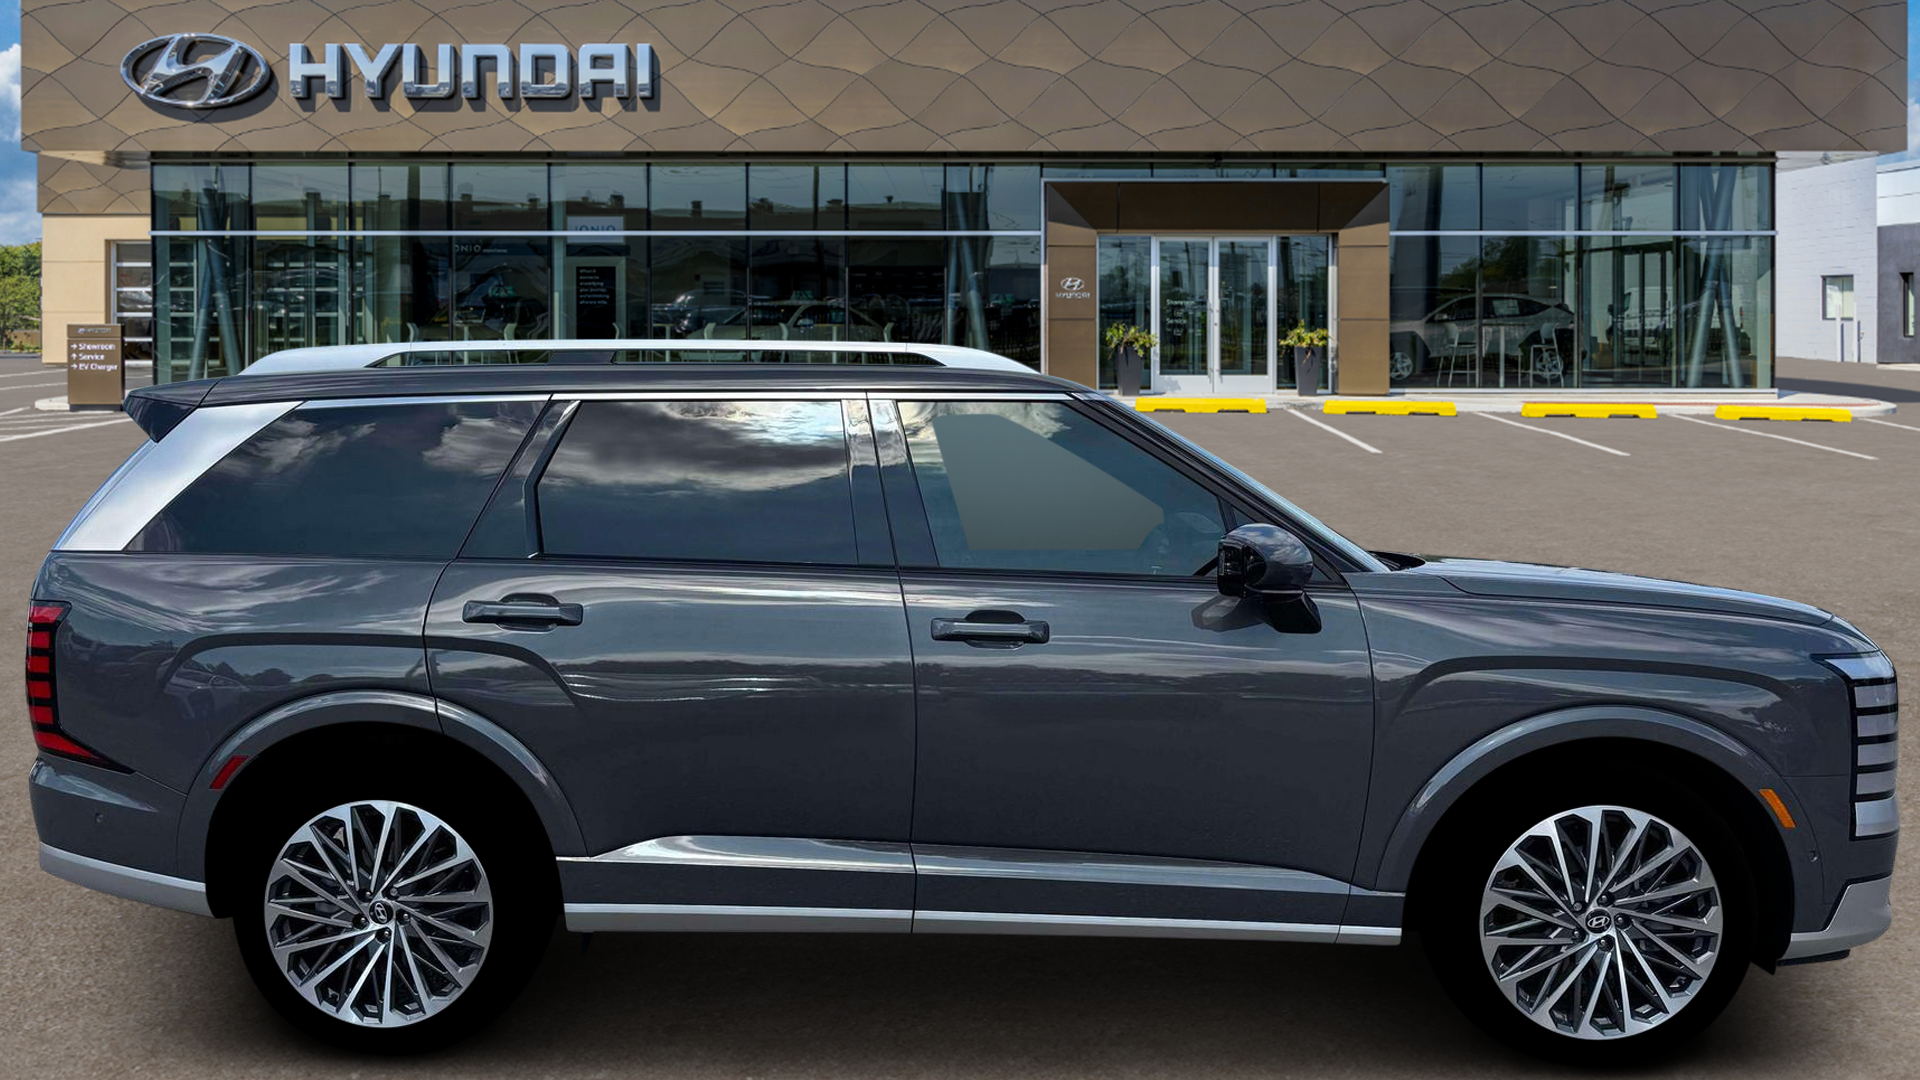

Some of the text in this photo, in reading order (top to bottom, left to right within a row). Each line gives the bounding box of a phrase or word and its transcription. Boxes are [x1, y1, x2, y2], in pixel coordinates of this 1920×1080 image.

[289, 43, 655, 100] HYUNDAI
[78, 342, 116, 350] Showroom
[78, 352, 105, 361] Service
[90, 363, 118, 372] Charger
